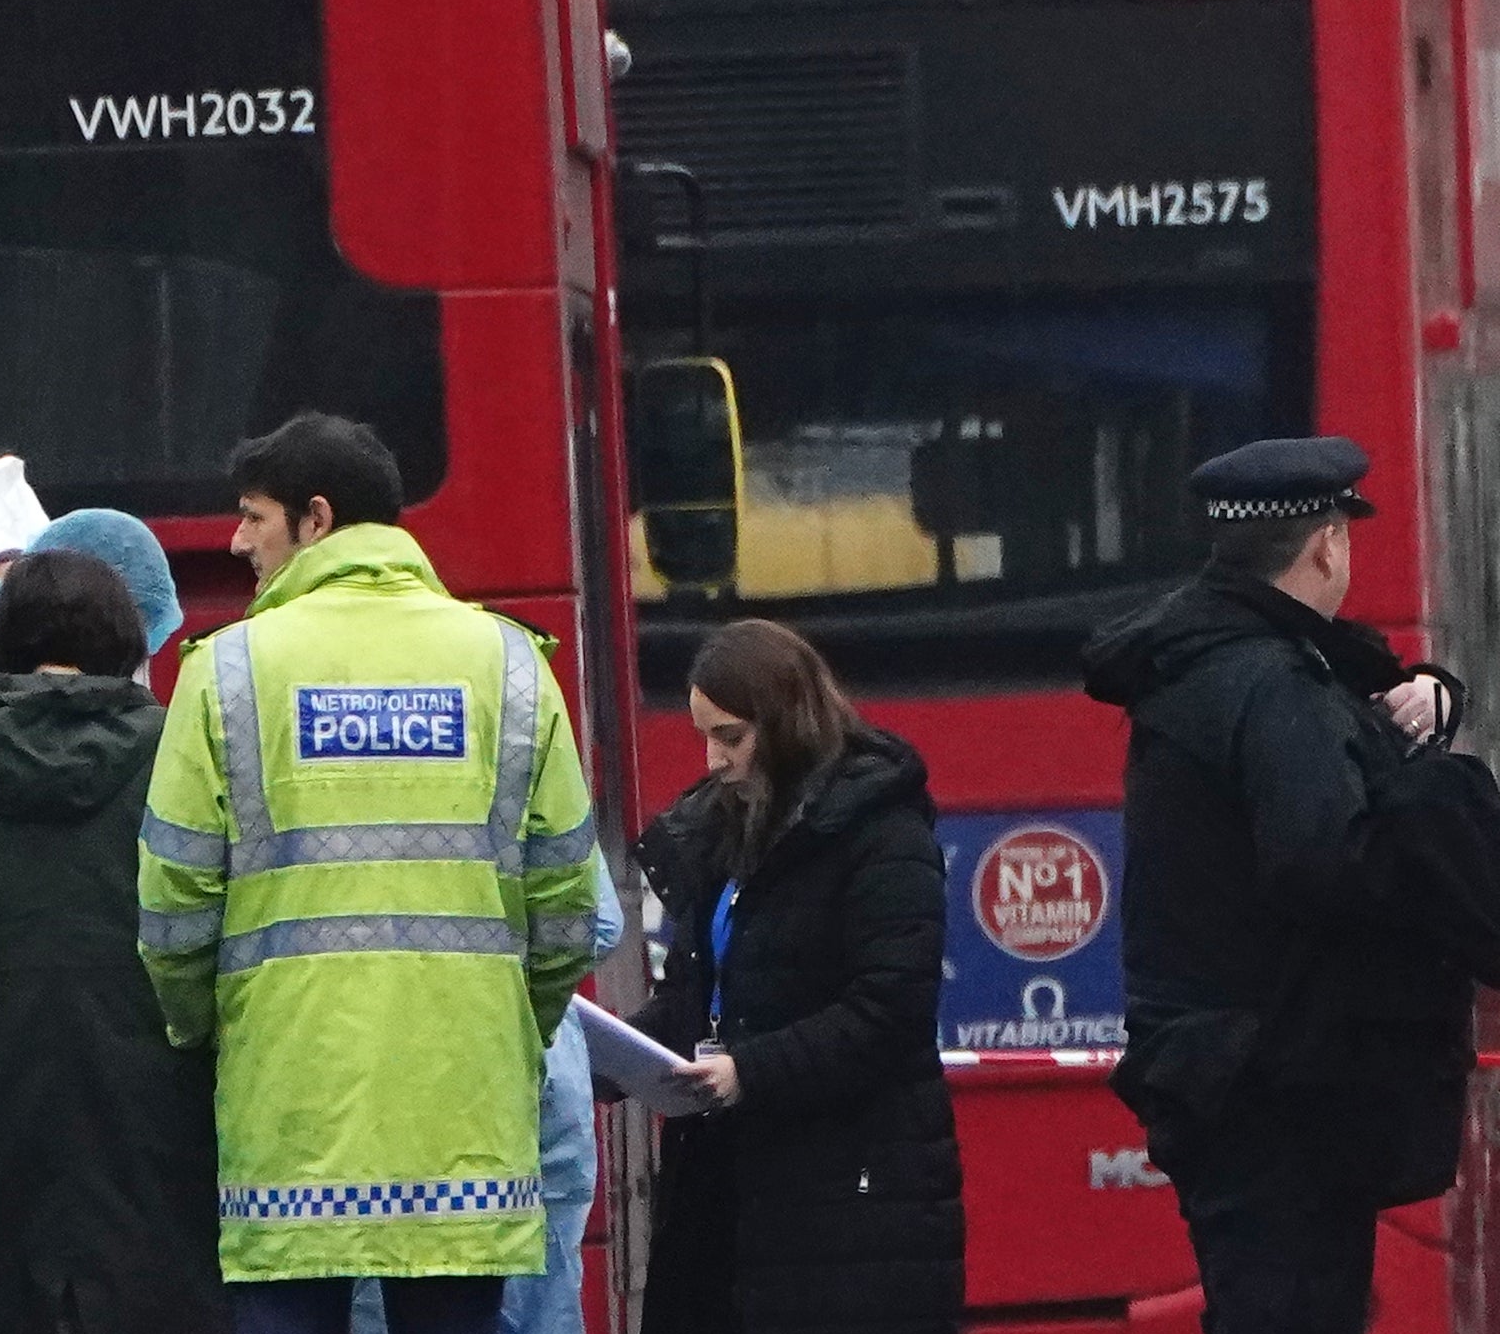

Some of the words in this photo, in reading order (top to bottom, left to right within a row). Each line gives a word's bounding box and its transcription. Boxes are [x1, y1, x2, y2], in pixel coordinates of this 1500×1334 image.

[68, 89, 316, 141] VWH2032
[1053, 179, 1270, 230] VMH2575
[311, 693, 454, 713] METROPOLITAN
[313, 714, 455, 753] POLICE
[993, 900, 1092, 926] VITAMIN
